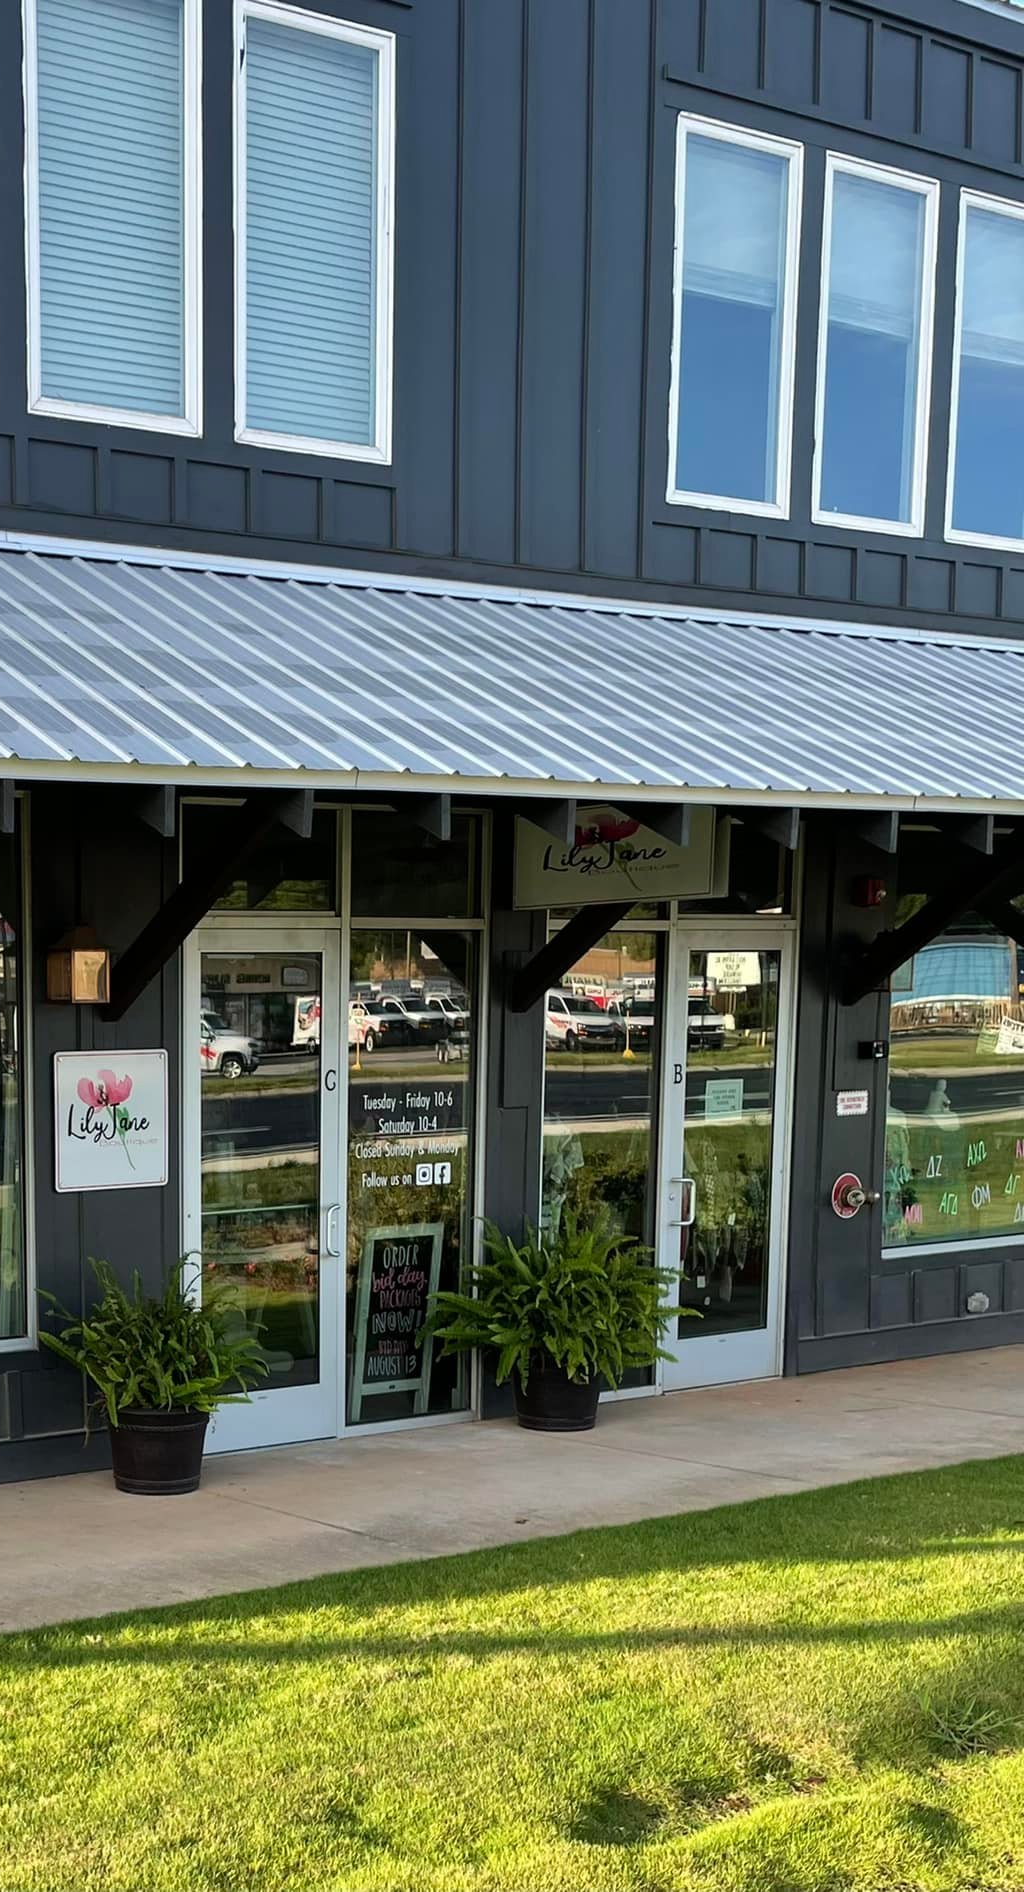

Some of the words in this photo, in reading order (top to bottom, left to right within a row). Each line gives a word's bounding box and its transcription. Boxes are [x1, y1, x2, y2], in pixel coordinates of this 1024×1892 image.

[674, 1064, 683, 1084] B
[362, 1092, 396, 1112] Tuesday
[406, 1091, 430, 1111] Friday
[434, 1091, 453, 1107] 10-6
[378, 1115, 415, 1135] Saturday
[418, 1116, 437, 1131] 10-4
[356, 1143, 382, 1159] Closed
[384, 1141, 415, 1159] Sunday
[427, 1140, 459, 1156] Monday
[362, 1172, 388, 1188] Follow
[390, 1176, 400, 1186] us
[402, 1174, 412, 1185] on
[383, 1244, 419, 1269] ORDER
[372, 1268, 395, 1293] bid
[397, 1266, 427, 1290] day
[367, 1355, 401, 1377] AUGUST
[405, 1354, 417, 1374] 13
